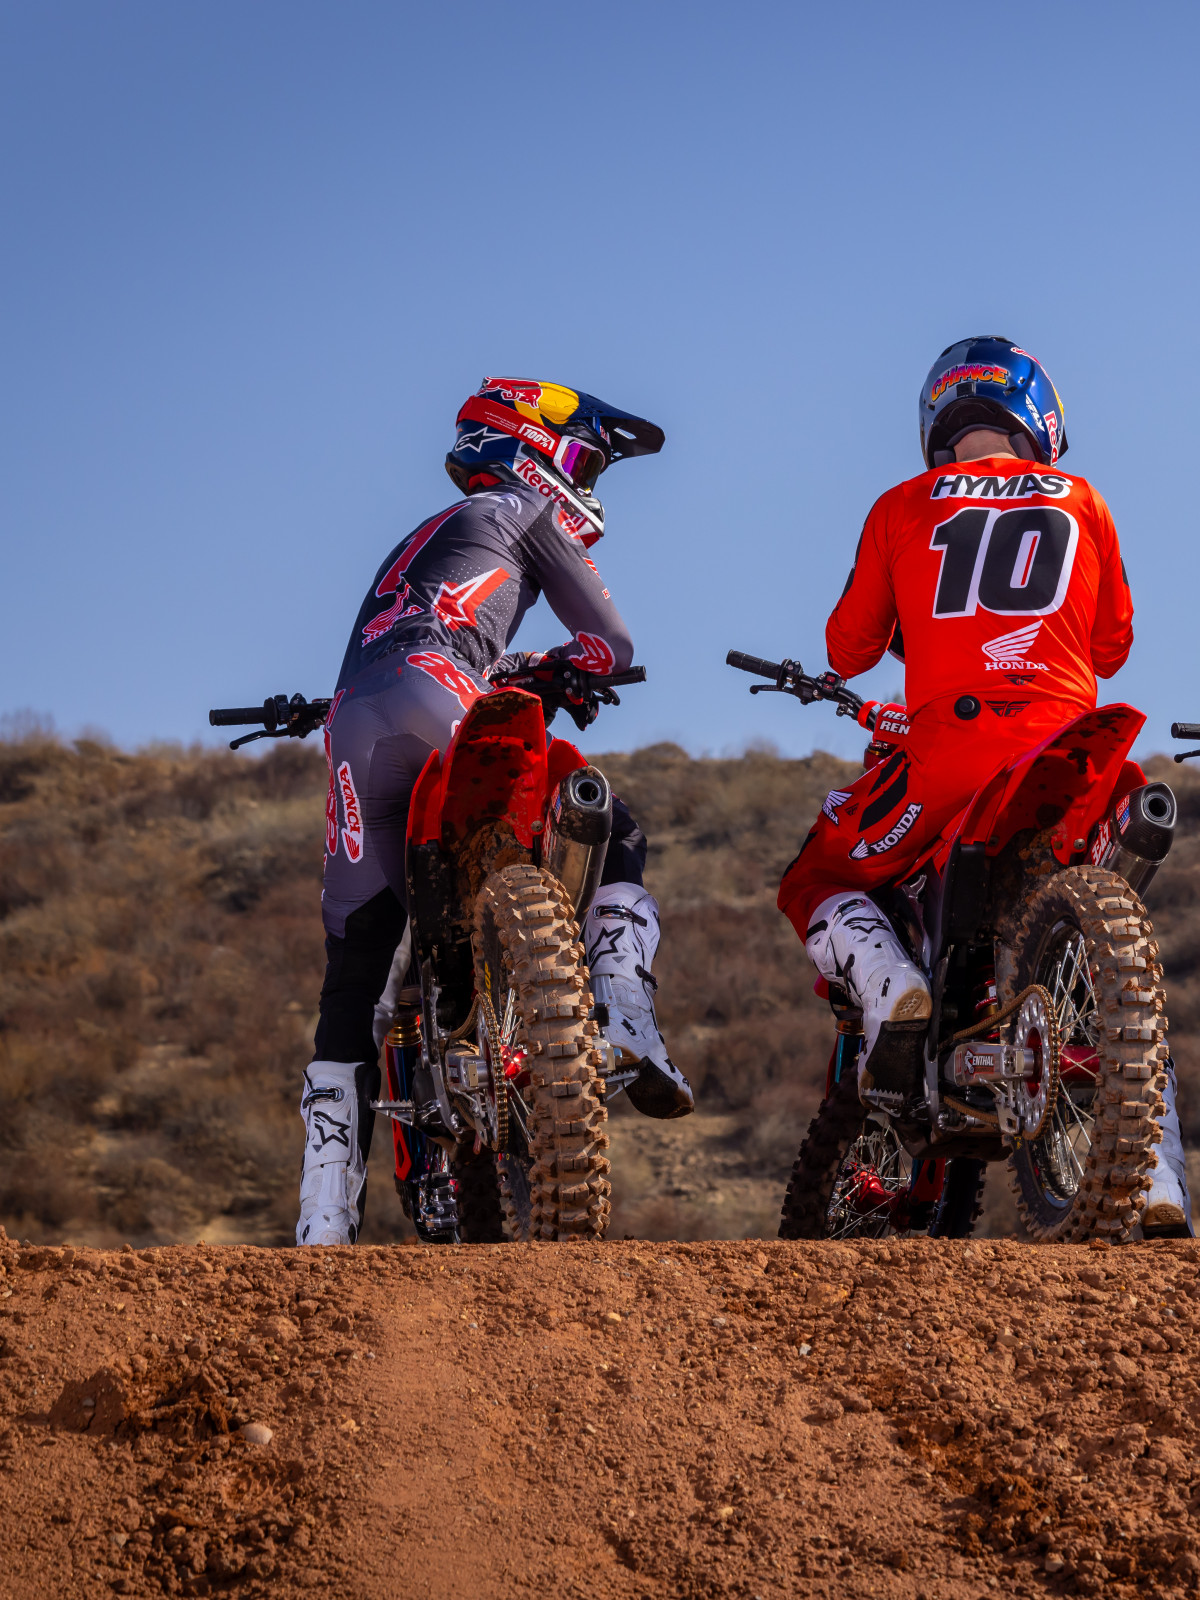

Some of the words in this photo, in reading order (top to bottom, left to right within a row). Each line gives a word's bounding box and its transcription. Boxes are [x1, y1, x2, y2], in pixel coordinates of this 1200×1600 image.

[930, 364, 1010, 402] CHANCE
[522, 427, 550, 448] 100%
[930, 473, 1073, 500] HYMAS
[929, 506, 1080, 619] 10
[984, 661, 1051, 671] HONDA
[336, 764, 361, 835] HONDA
[870, 802, 923, 854] HONDA
